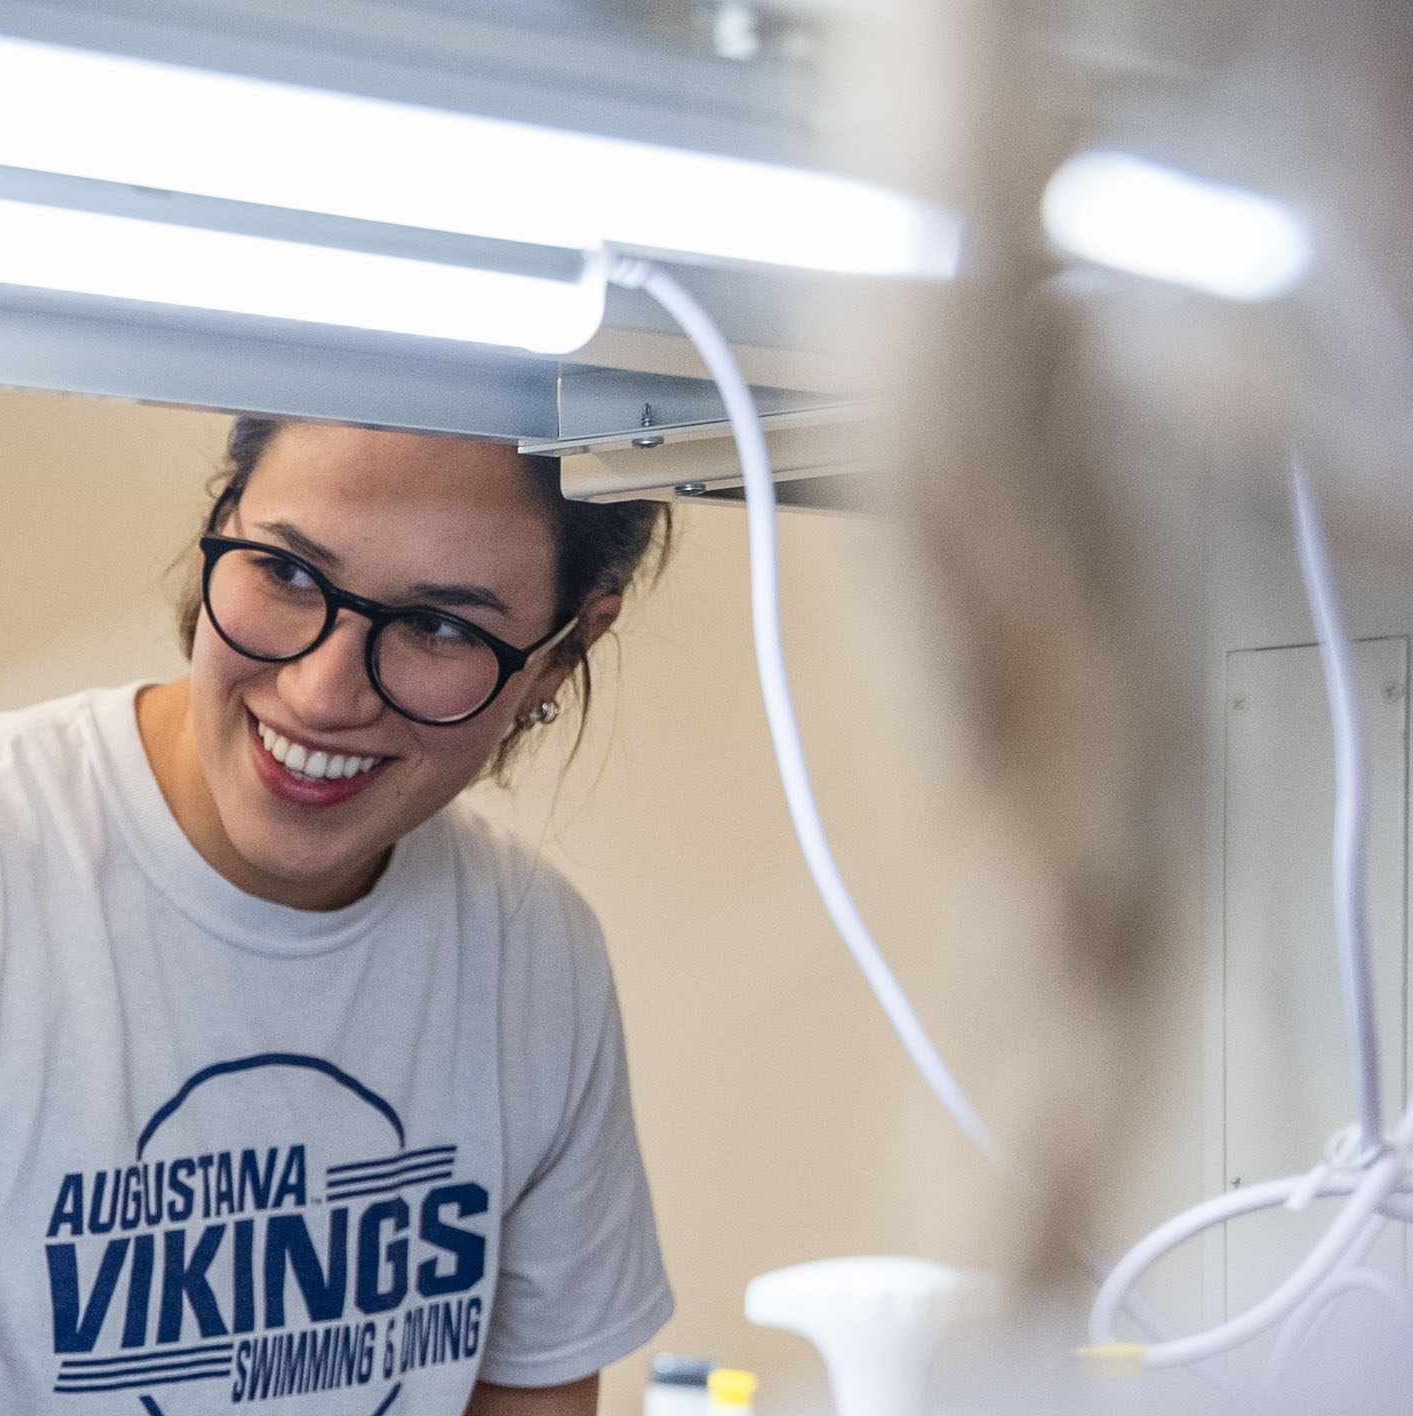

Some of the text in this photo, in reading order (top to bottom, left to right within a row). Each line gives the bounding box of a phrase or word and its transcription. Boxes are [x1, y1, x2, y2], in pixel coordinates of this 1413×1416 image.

[46, 1144, 305, 1237] AUGUSTANA
[45, 1182, 489, 1354] VIKINGS
[231, 1321, 376, 1404] SWIMMING
[400, 1297, 482, 1374] DIVING
